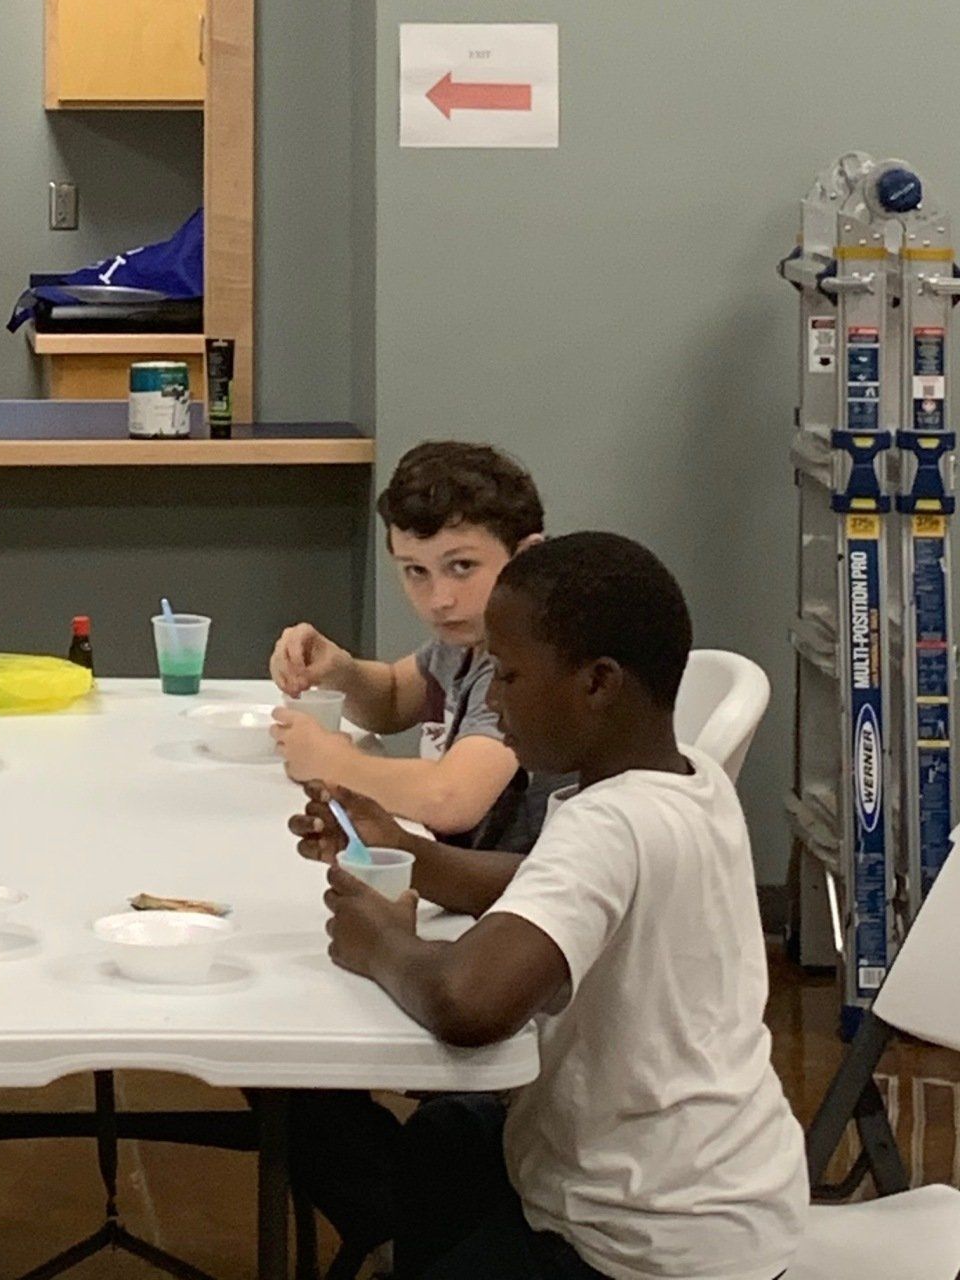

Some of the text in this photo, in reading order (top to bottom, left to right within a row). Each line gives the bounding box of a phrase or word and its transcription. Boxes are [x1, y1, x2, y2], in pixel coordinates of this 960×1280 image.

[851, 551, 871, 689] MULTI-POSITION PRO
[862, 728, 878, 805] WERNER
